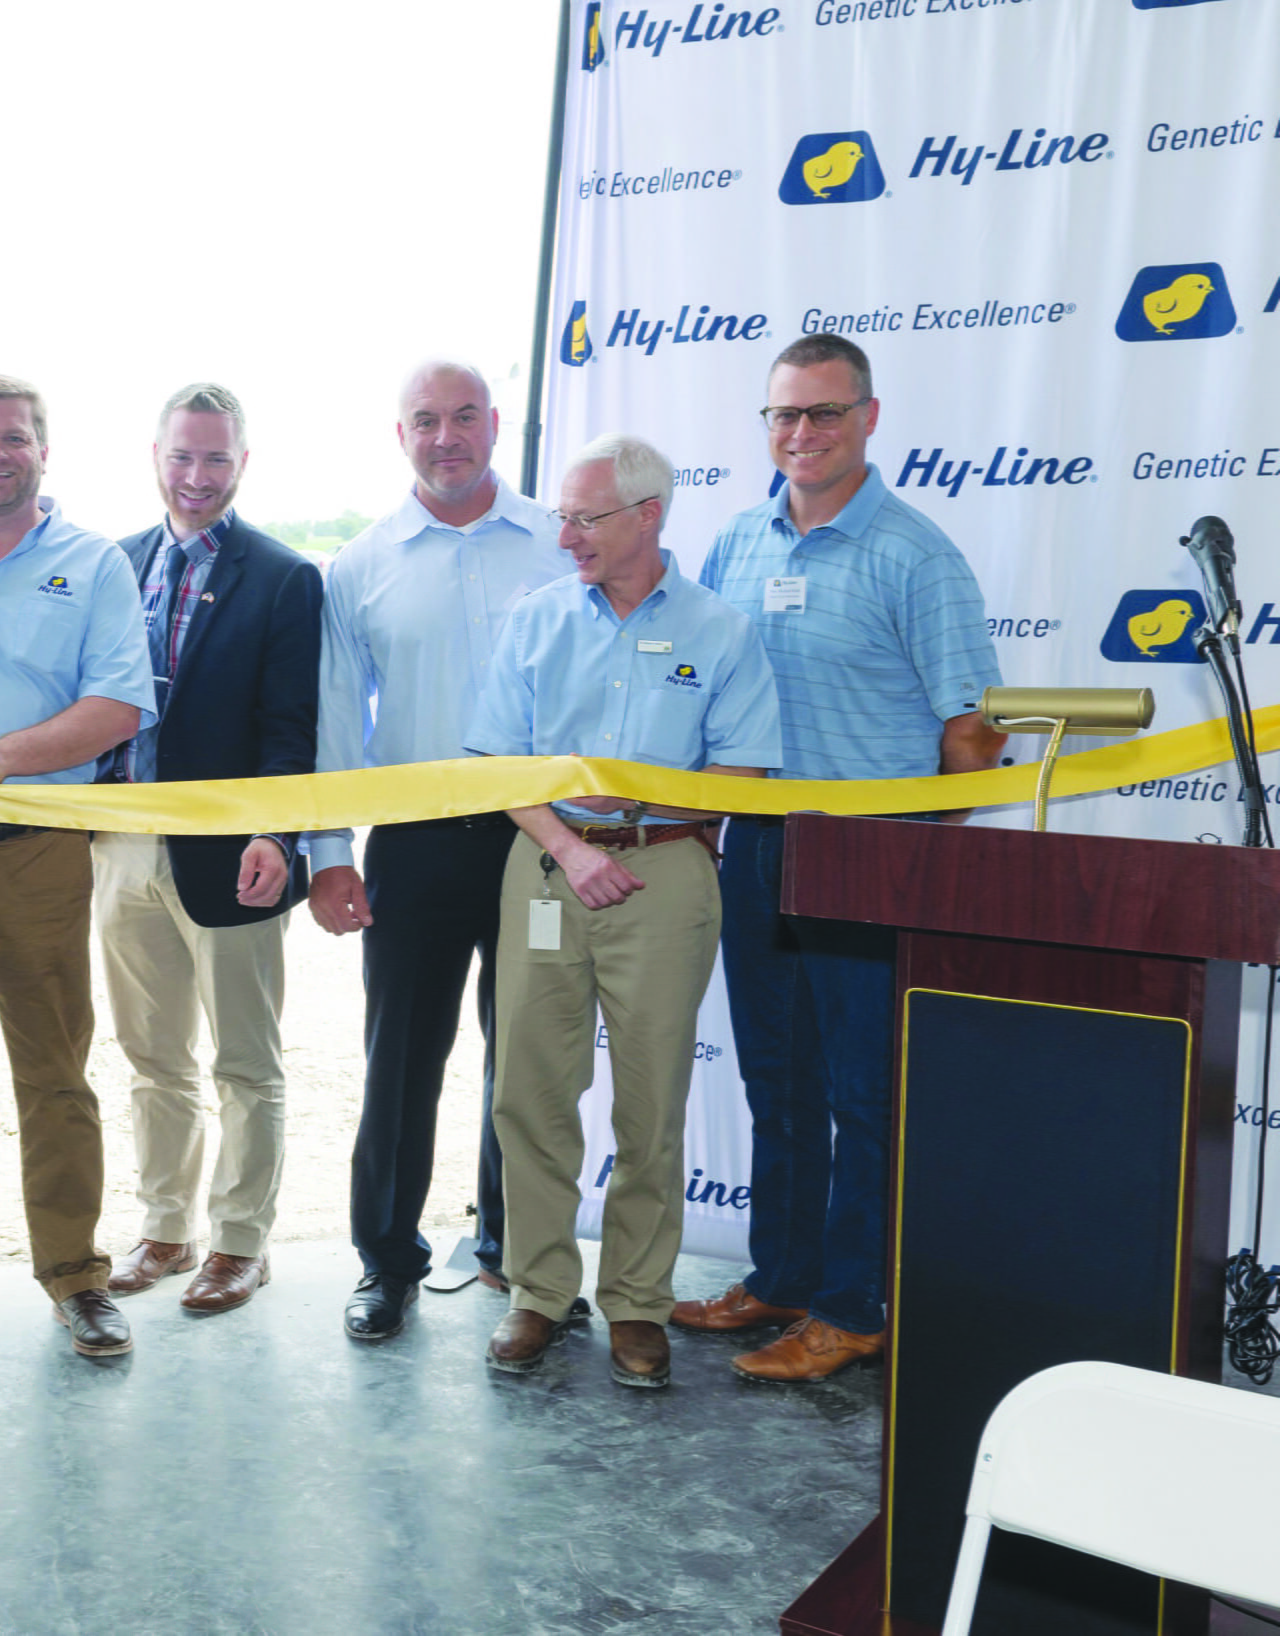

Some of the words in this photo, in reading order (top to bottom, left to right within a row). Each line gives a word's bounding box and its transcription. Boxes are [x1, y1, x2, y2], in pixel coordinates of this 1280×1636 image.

[1146, 113, 1264, 153] Genetic
[801, 305, 903, 335] Genetic
[1133, 449, 1247, 480] Genetic
[37, 585, 73, 597] Hy-Line
[665, 675, 703, 688] Hy-Line
